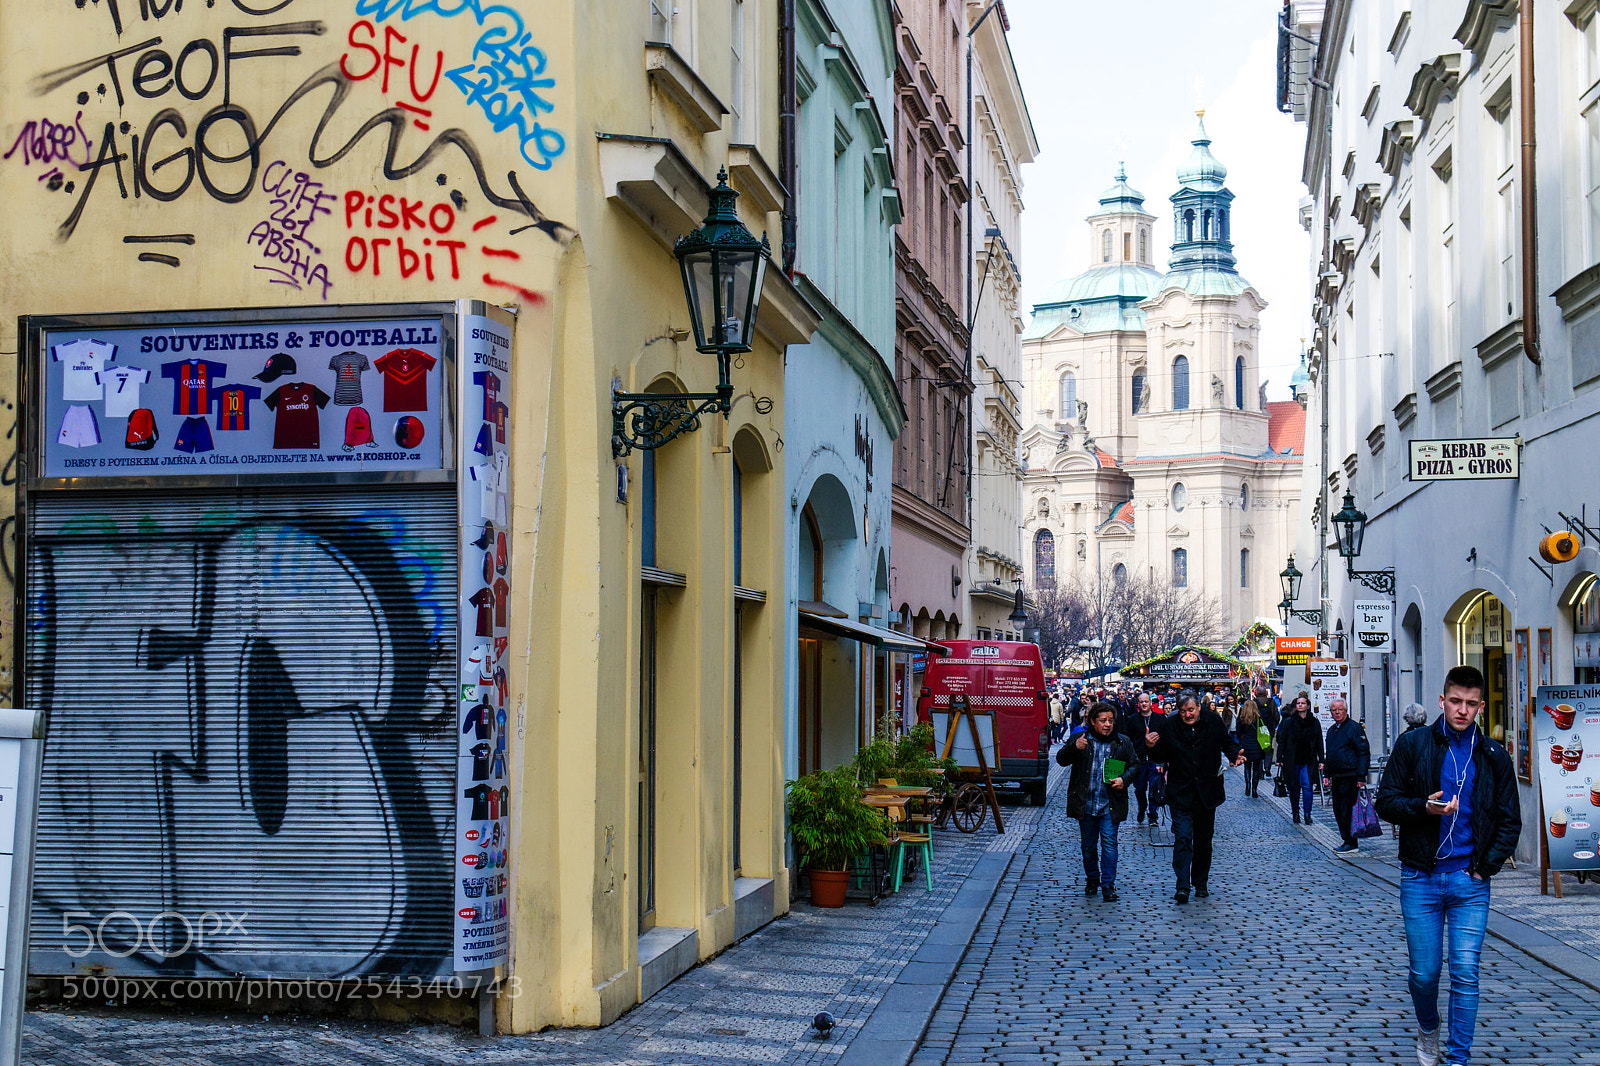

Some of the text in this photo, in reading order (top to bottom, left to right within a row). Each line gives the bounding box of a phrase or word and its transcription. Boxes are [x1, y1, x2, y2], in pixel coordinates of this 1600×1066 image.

[340, 20, 443, 102] SFU
[140, 327, 437, 353] SOUVENIRS & FOOTBALL
[474, 352, 508, 373] FOOTBALL
[117, 377, 127, 394] 7
[183, 378, 205, 386] QATAR
[228, 396, 239, 411] 10
[1442, 443, 1486, 458] KEBAB
[64, 458, 98, 468] DRESY
[99, 458, 106, 467] S
[108, 457, 159, 467] POTISKEM
[161, 455, 197, 466] JMÉNA
[199, 457, 207, 465] A
[209, 454, 238, 465] ČÍSLA
[241, 454, 308, 464] OBJEDNEJTE
[310, 453, 325, 463] NA
[1417, 460, 1454, 475] PIZZA
[1468, 458, 1512, 474] GYROS
[1356, 603, 1390, 611] espresso
[1363, 613, 1384, 622] bar
[1359, 632, 1390, 642] bistro
[463, 925, 494, 938] POTISK
